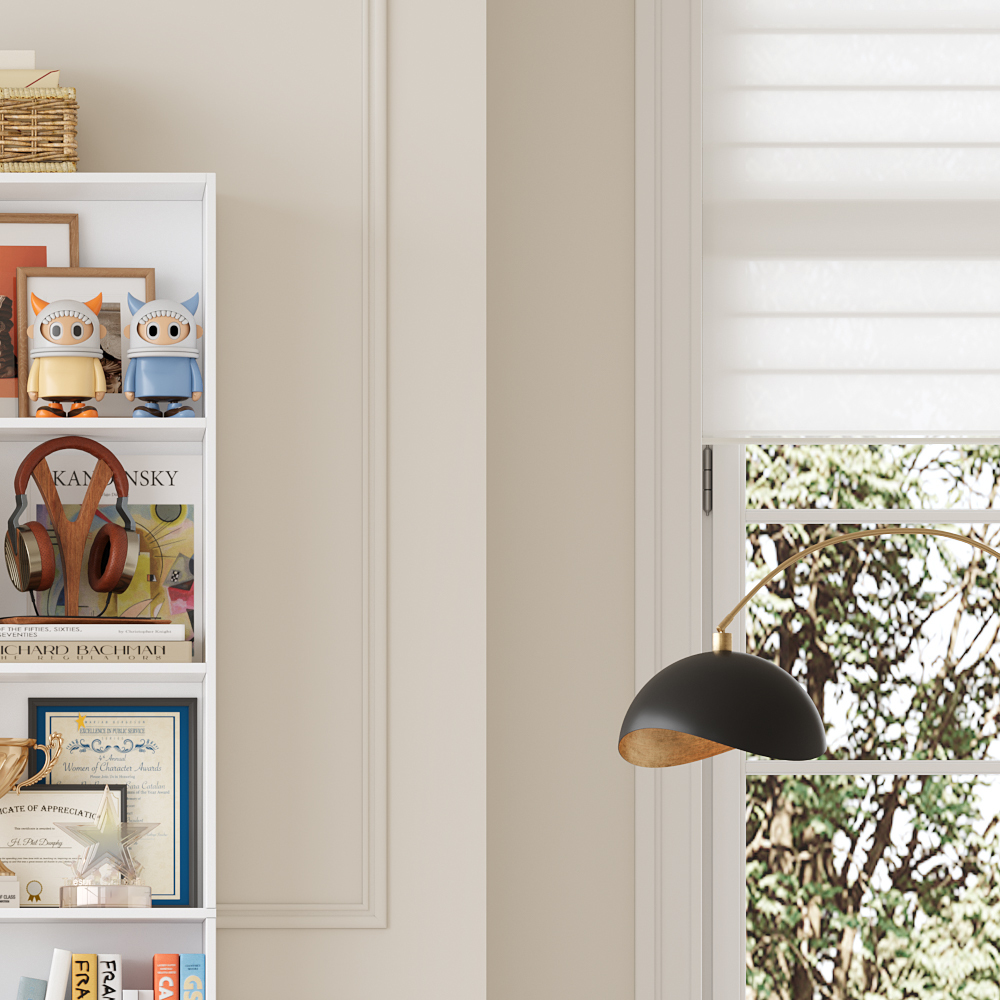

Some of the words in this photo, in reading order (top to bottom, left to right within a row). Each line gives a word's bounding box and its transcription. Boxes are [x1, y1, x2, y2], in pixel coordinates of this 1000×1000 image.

[77, 645, 166, 655] BACHMAN
[63, 762, 90, 771] Women
[92, 762, 100, 774] of
[100, 762, 132, 772] Character
[134, 762, 162, 771] Awards
